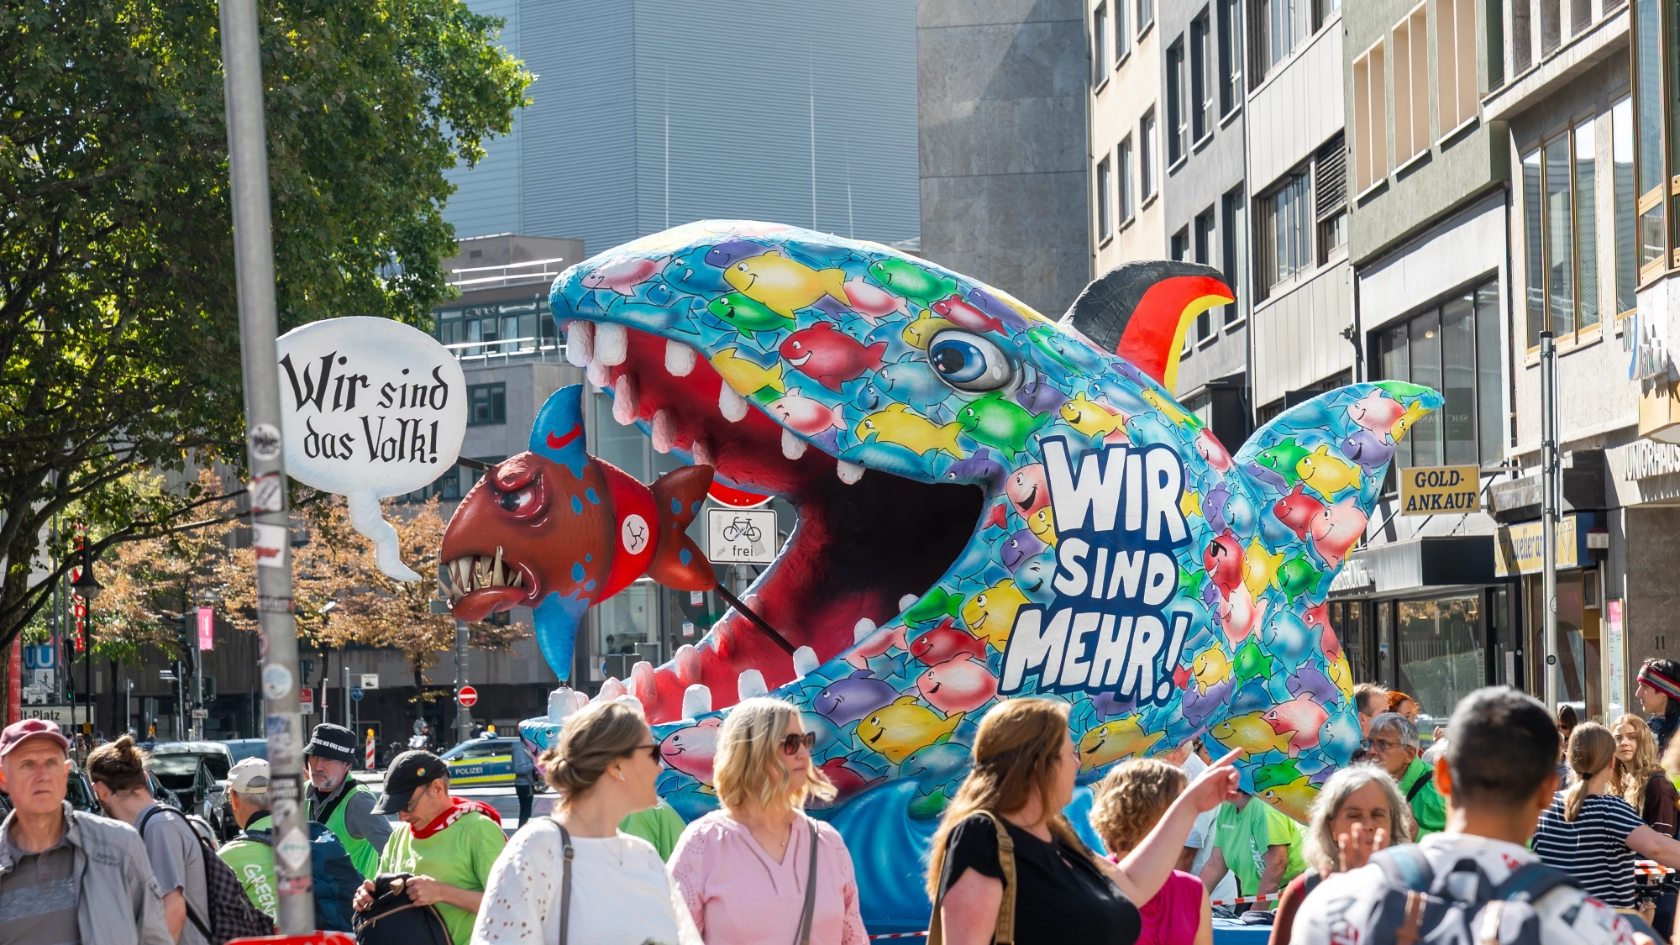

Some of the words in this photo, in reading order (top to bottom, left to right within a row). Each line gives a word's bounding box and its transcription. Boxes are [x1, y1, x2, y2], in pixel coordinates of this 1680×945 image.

[278, 351, 371, 413] Wir
[376, 364, 449, 411] sind
[304, 415, 355, 460] das
[358, 414, 440, 464] Volk!
[1414, 470, 1465, 488] GOLD-
[1041, 439, 1189, 544] WIR
[1405, 492, 1477, 511] ANKAUF
[732, 545, 754, 557] frei
[1052, 536, 1176, 606] SIND
[1654, 635, 1666, 650] 11
[36, 647, 54, 667] U
[1000, 606, 1190, 702] MEHR!
[455, 766, 483, 776] POLIZEI
